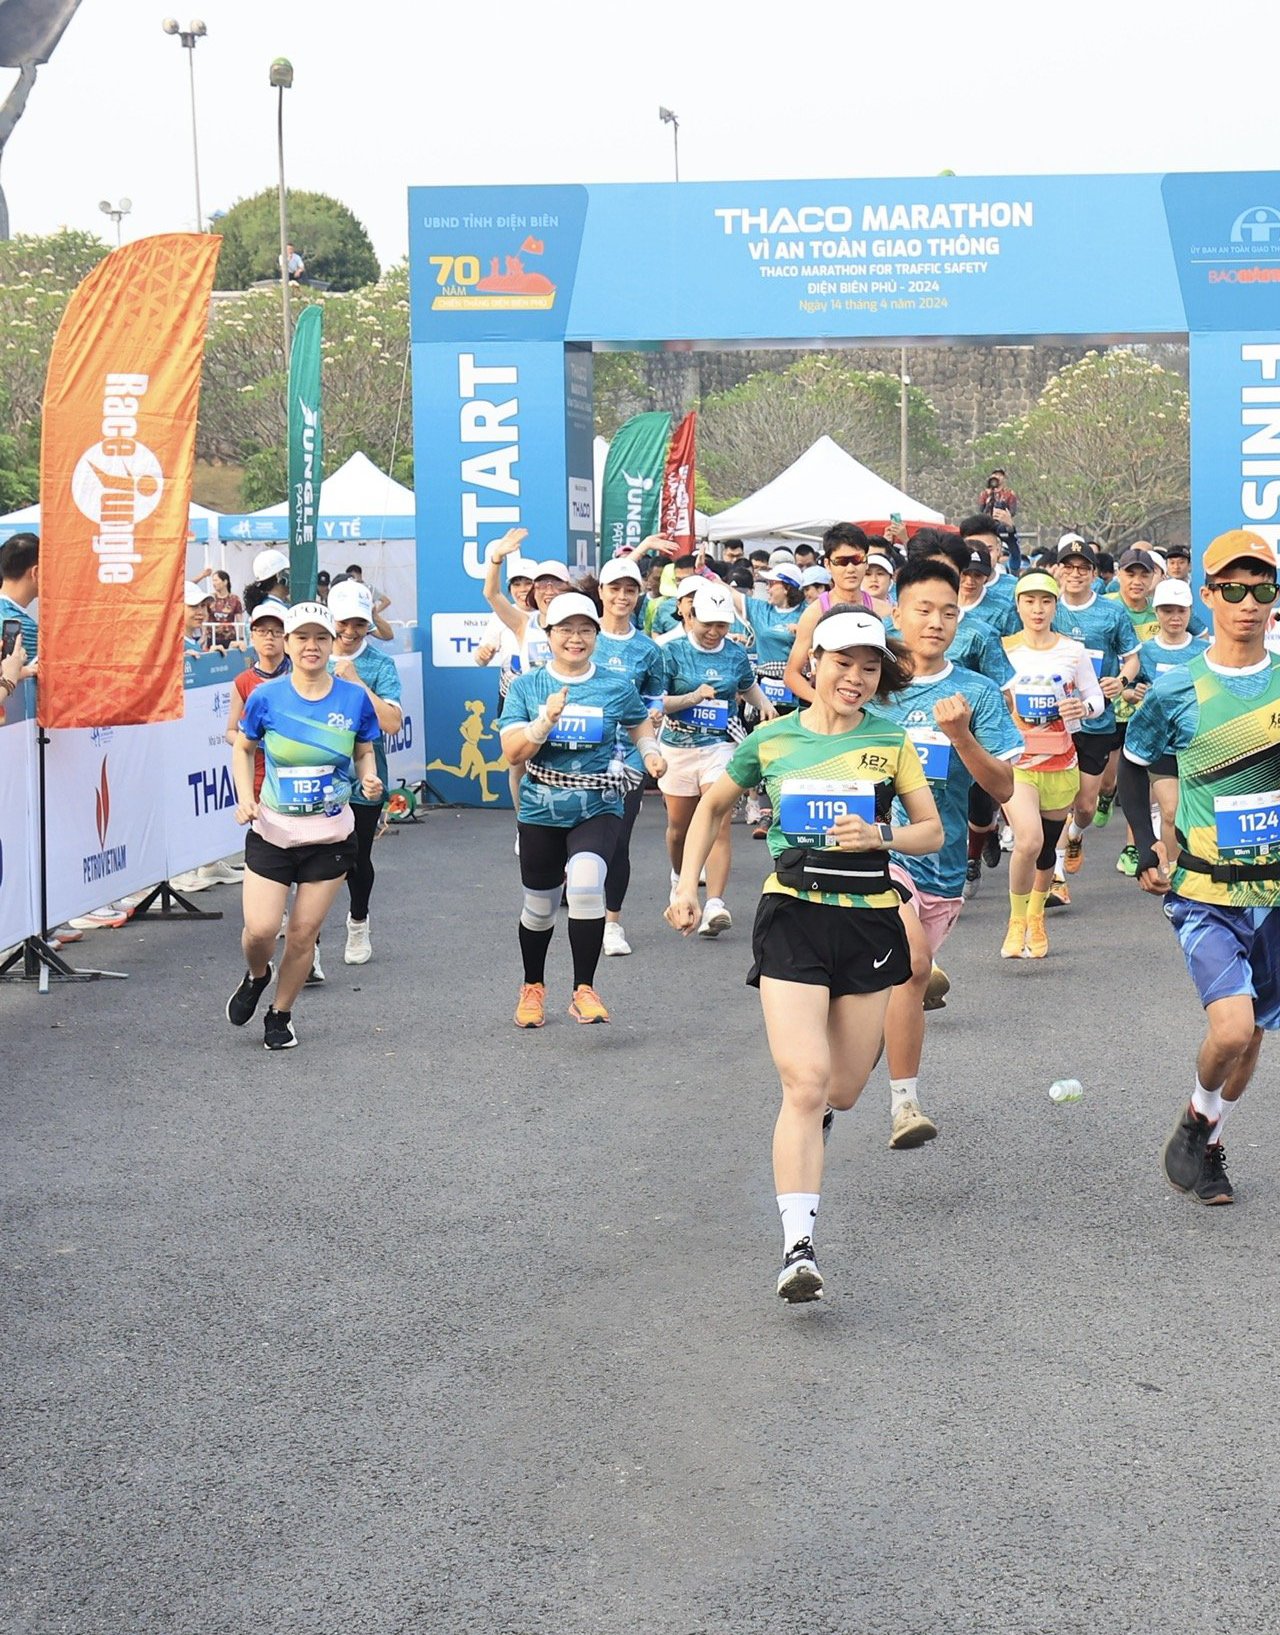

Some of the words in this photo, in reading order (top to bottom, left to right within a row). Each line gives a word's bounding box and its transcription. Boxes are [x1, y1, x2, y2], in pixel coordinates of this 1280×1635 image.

[424, 216, 460, 228] UBND
[463, 213, 493, 228] TỈNH
[496, 213, 526, 232] ĐIỆN
[531, 213, 559, 228] BIÊN
[714, 206, 853, 235] THACO
[862, 202, 1033, 232] MARATHON
[748, 238, 770, 260] VÌ
[774, 241, 805, 260] AN
[810, 236, 867, 259] TOÀN
[872, 238, 922, 258] GIAO
[927, 233, 1000, 257] THÔNG
[429, 255, 480, 286] 70
[759, 266, 799, 278] THACO
[801, 264, 867, 277] MARATHON
[869, 264, 892, 275] FOR
[895, 263, 942, 275] TRAFFIC
[944, 261, 988, 274] SAFETY
[807, 280, 837, 297] ĐIỆN
[840, 280, 868, 294] BIÊN
[871, 279, 897, 293] PHỦ
[908, 280, 940, 293] 2024
[799, 300, 827, 313] Ngày
[831, 300, 842, 310] 14
[845, 299, 878, 312] tháng
[919, 297, 948, 309] 2024
[101, 373, 149, 456] Race
[458, 352, 519, 581] START
[621, 469, 654, 549] JUNGL
[324, 521, 335, 537] Y
[340, 517, 361, 537] TẾ
[765, 687, 784, 697] 1070
[1028, 696, 1056, 709] 1158
[328, 712, 344, 727] 28
[693, 708, 717, 720] 1166
[558, 718, 586, 732] 1771
[869, 754, 888, 766] 27
[293, 779, 321, 794] 1132
[807, 800, 848, 819] 1119
[1238, 809, 1279, 833] 1124
[83, 845, 126, 884] PETROVIETNAM
